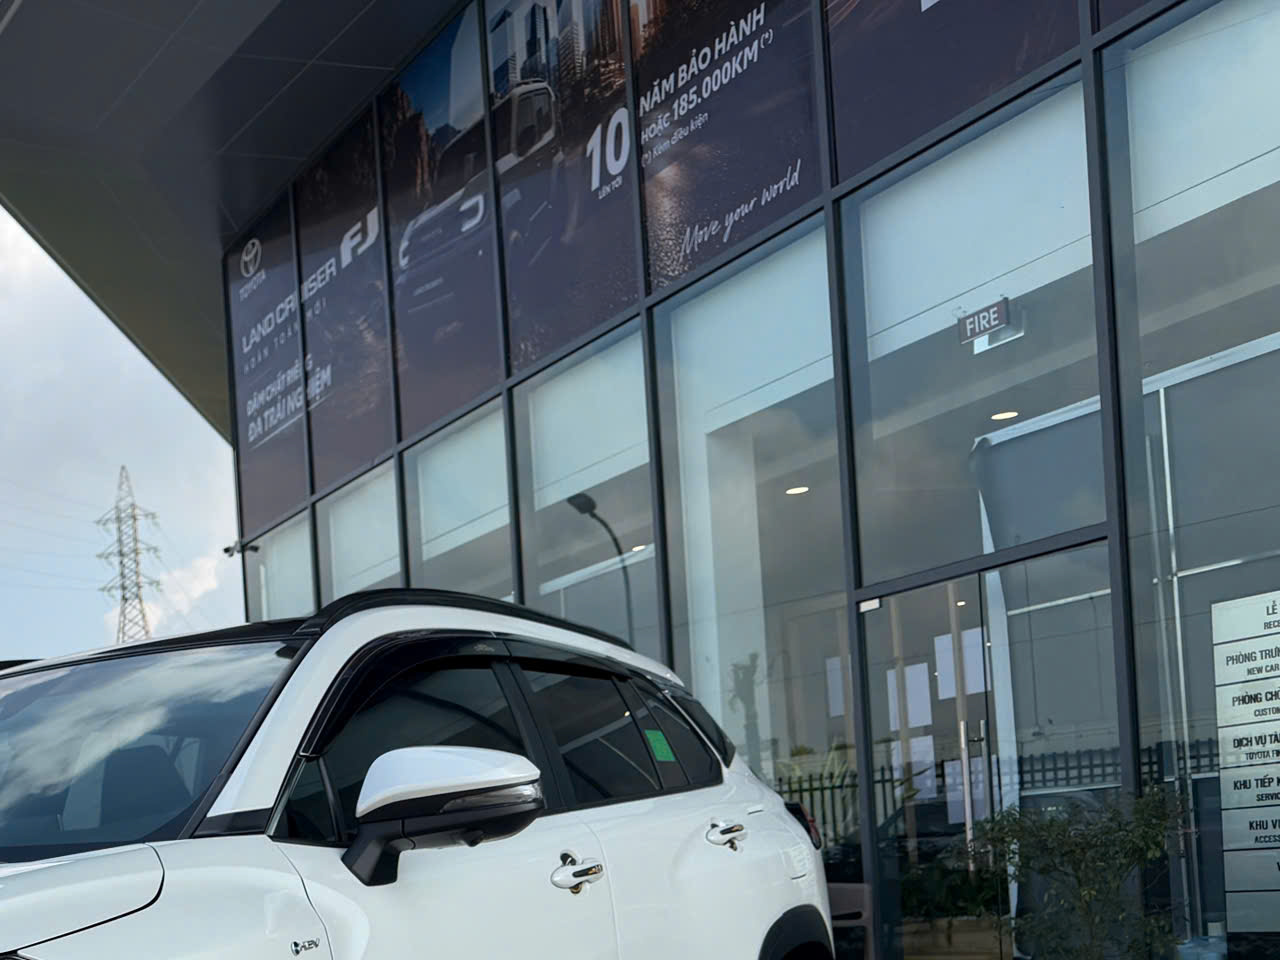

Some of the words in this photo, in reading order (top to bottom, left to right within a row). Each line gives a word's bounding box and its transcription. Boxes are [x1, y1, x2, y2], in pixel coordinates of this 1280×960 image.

[639, 72, 675, 117] NĂM
[677, 48, 712, 89] BẢO
[714, 2, 765, 60] HÀNH
[640, 112, 670, 145] HOẶC
[586, 106, 631, 192] 10
[679, 220, 721, 263] Move
[723, 197, 758, 243] your
[241, 311, 275, 354] LAND
[276, 257, 337, 324] CRISER
[339, 205, 381, 270] FJ
[965, 307, 999, 337] FIRE
[1226, 651, 1257, 667] PHÒNG
[1247, 664, 1262, 676] NEW
[1265, 663, 1280, 673] CAR
[1232, 691, 1262, 707] PHÒNG
[1245, 751, 1270, 761] TOYOTA
[1233, 779, 1252, 791] KHU
[1254, 774, 1274, 789] TIẾP
[1249, 820, 1268, 831] KHU
